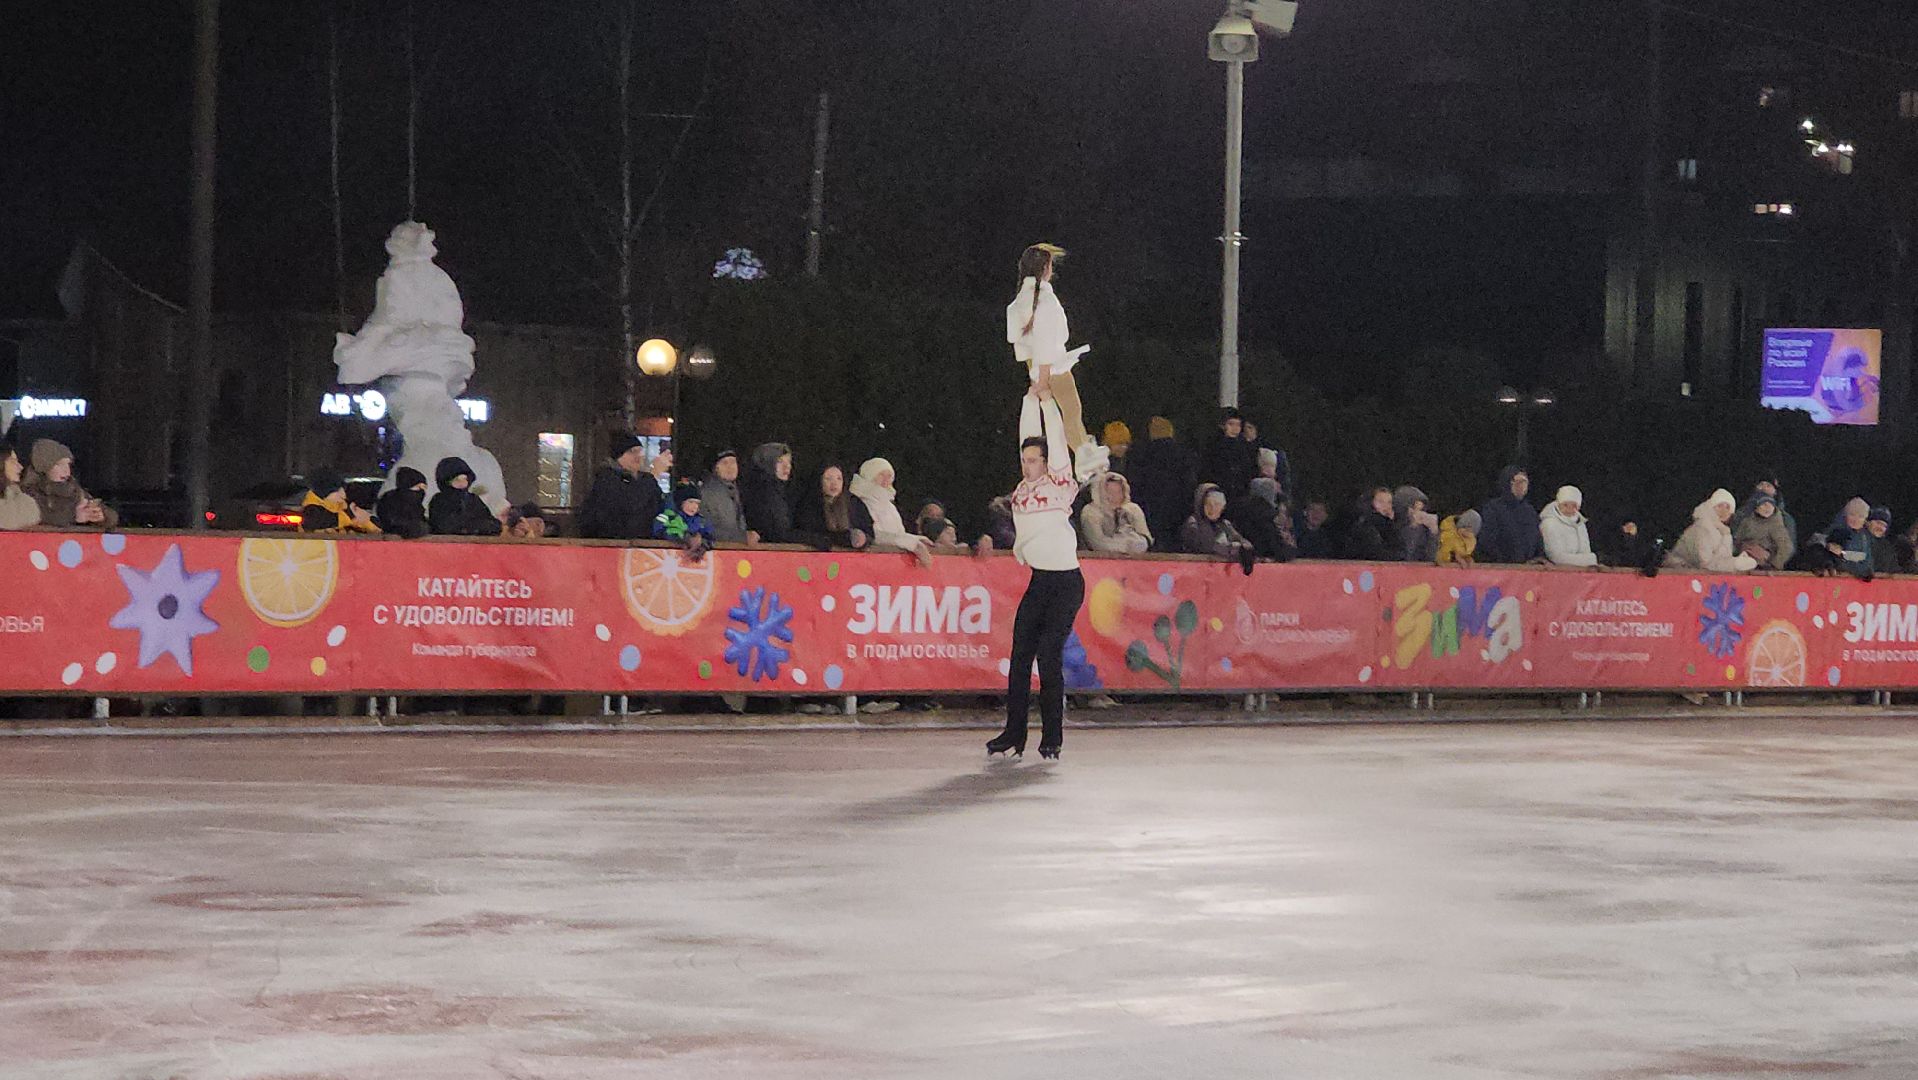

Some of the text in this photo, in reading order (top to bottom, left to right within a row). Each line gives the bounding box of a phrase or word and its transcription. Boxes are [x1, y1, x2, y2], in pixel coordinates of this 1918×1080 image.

[417, 574, 532, 599] КАТАЙТЕСЬ
[373, 604, 574, 628] С УДОВОЛЬСТВИЕМ!
[1575, 597, 1648, 616] КАТАЙТЕСЬ
